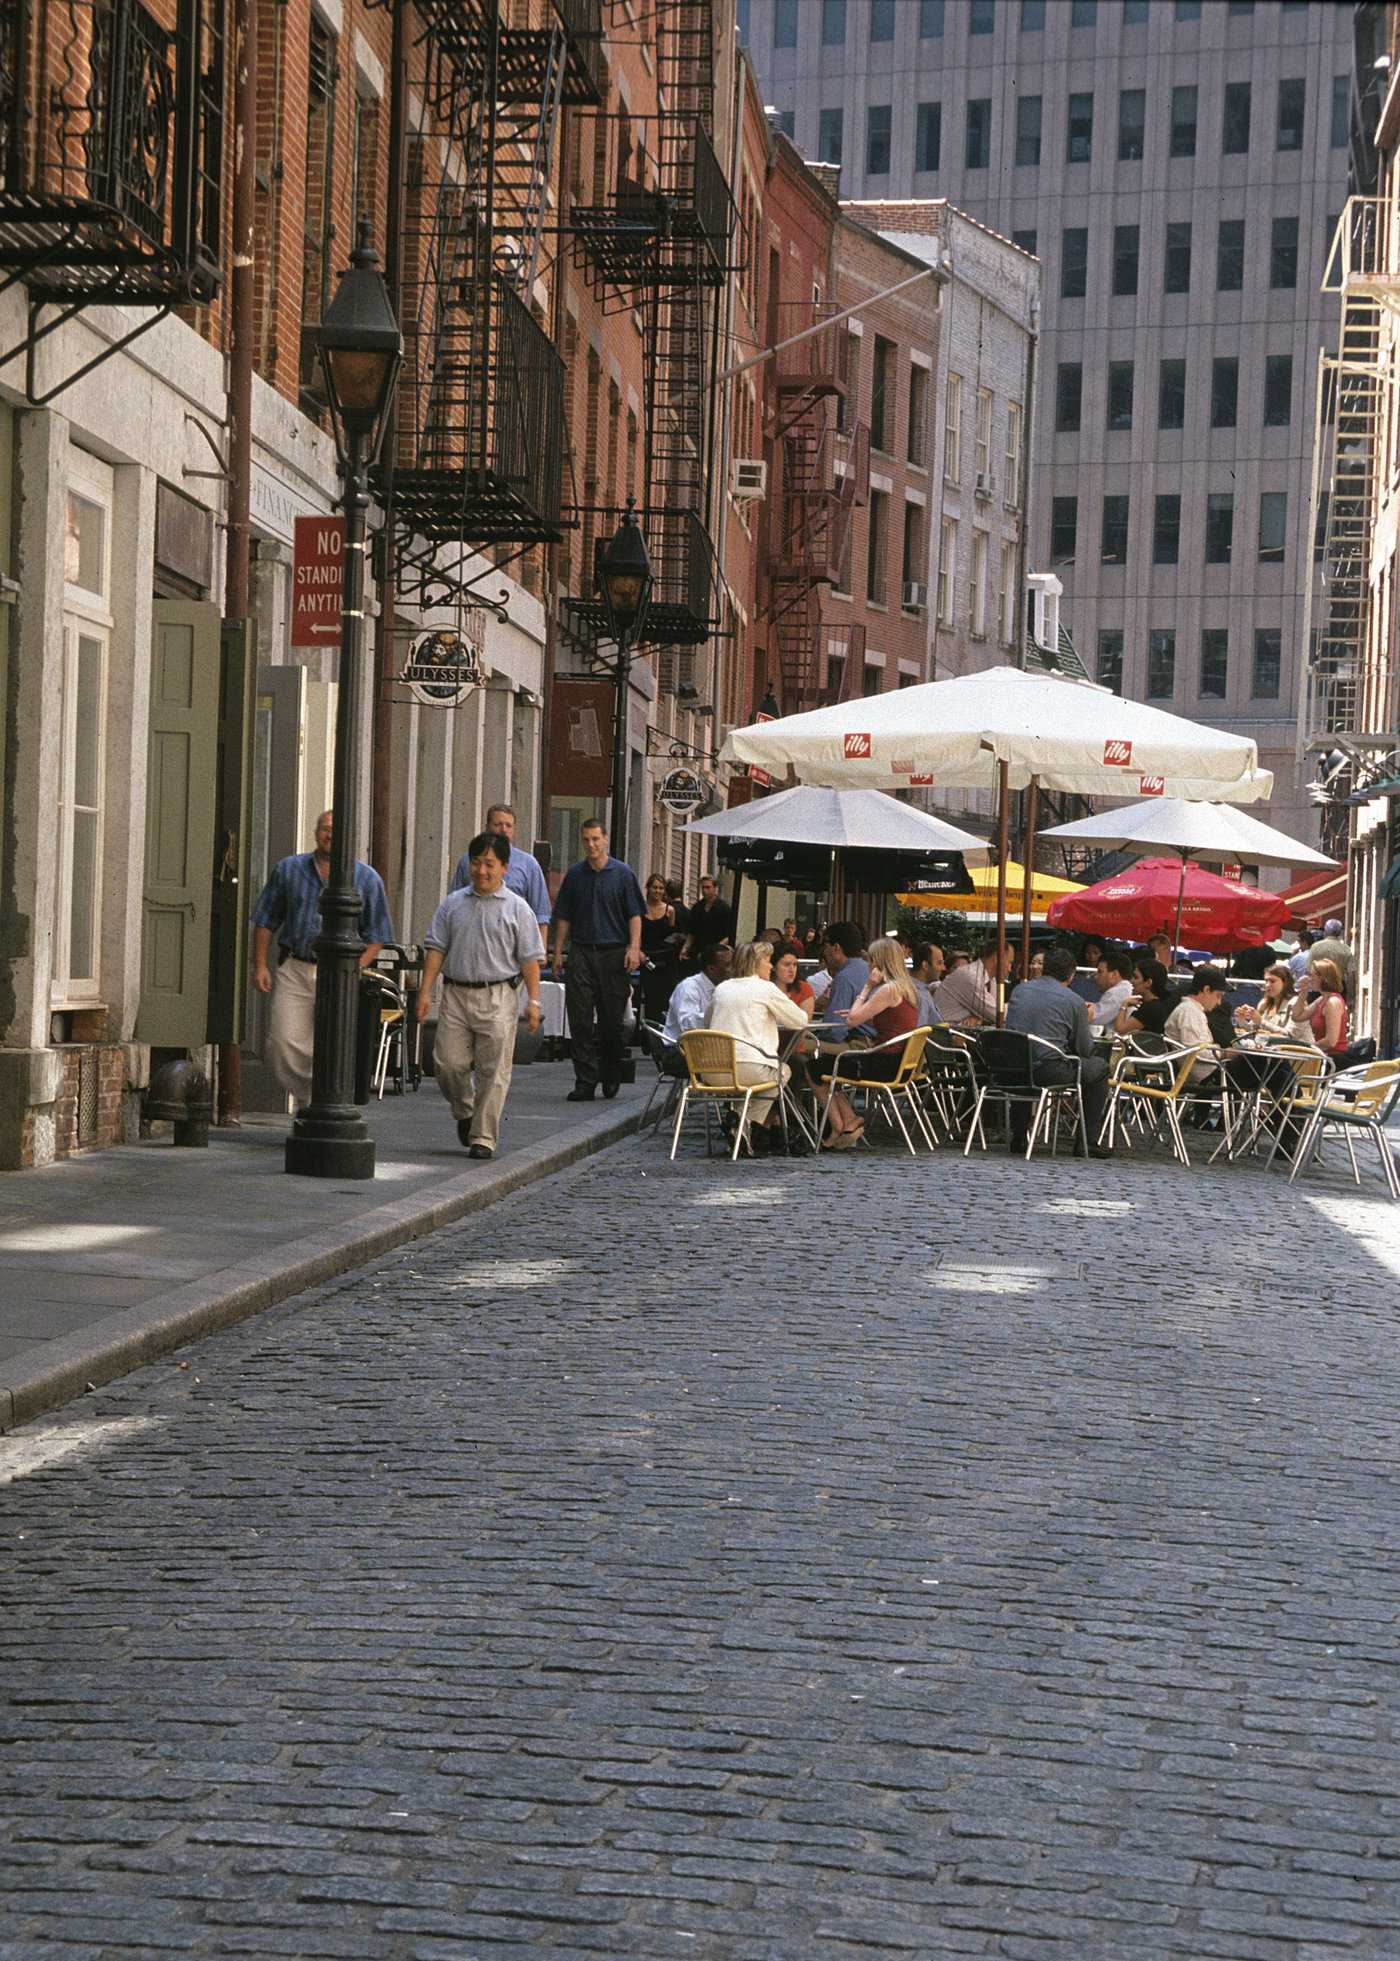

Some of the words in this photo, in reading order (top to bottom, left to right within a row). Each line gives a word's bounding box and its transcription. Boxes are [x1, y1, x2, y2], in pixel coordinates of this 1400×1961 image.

[317, 531, 341, 555] NO
[411, 668, 474, 681] ULYSSES
[845, 735, 869, 756] illy
[1105, 742, 1130, 763] illy
